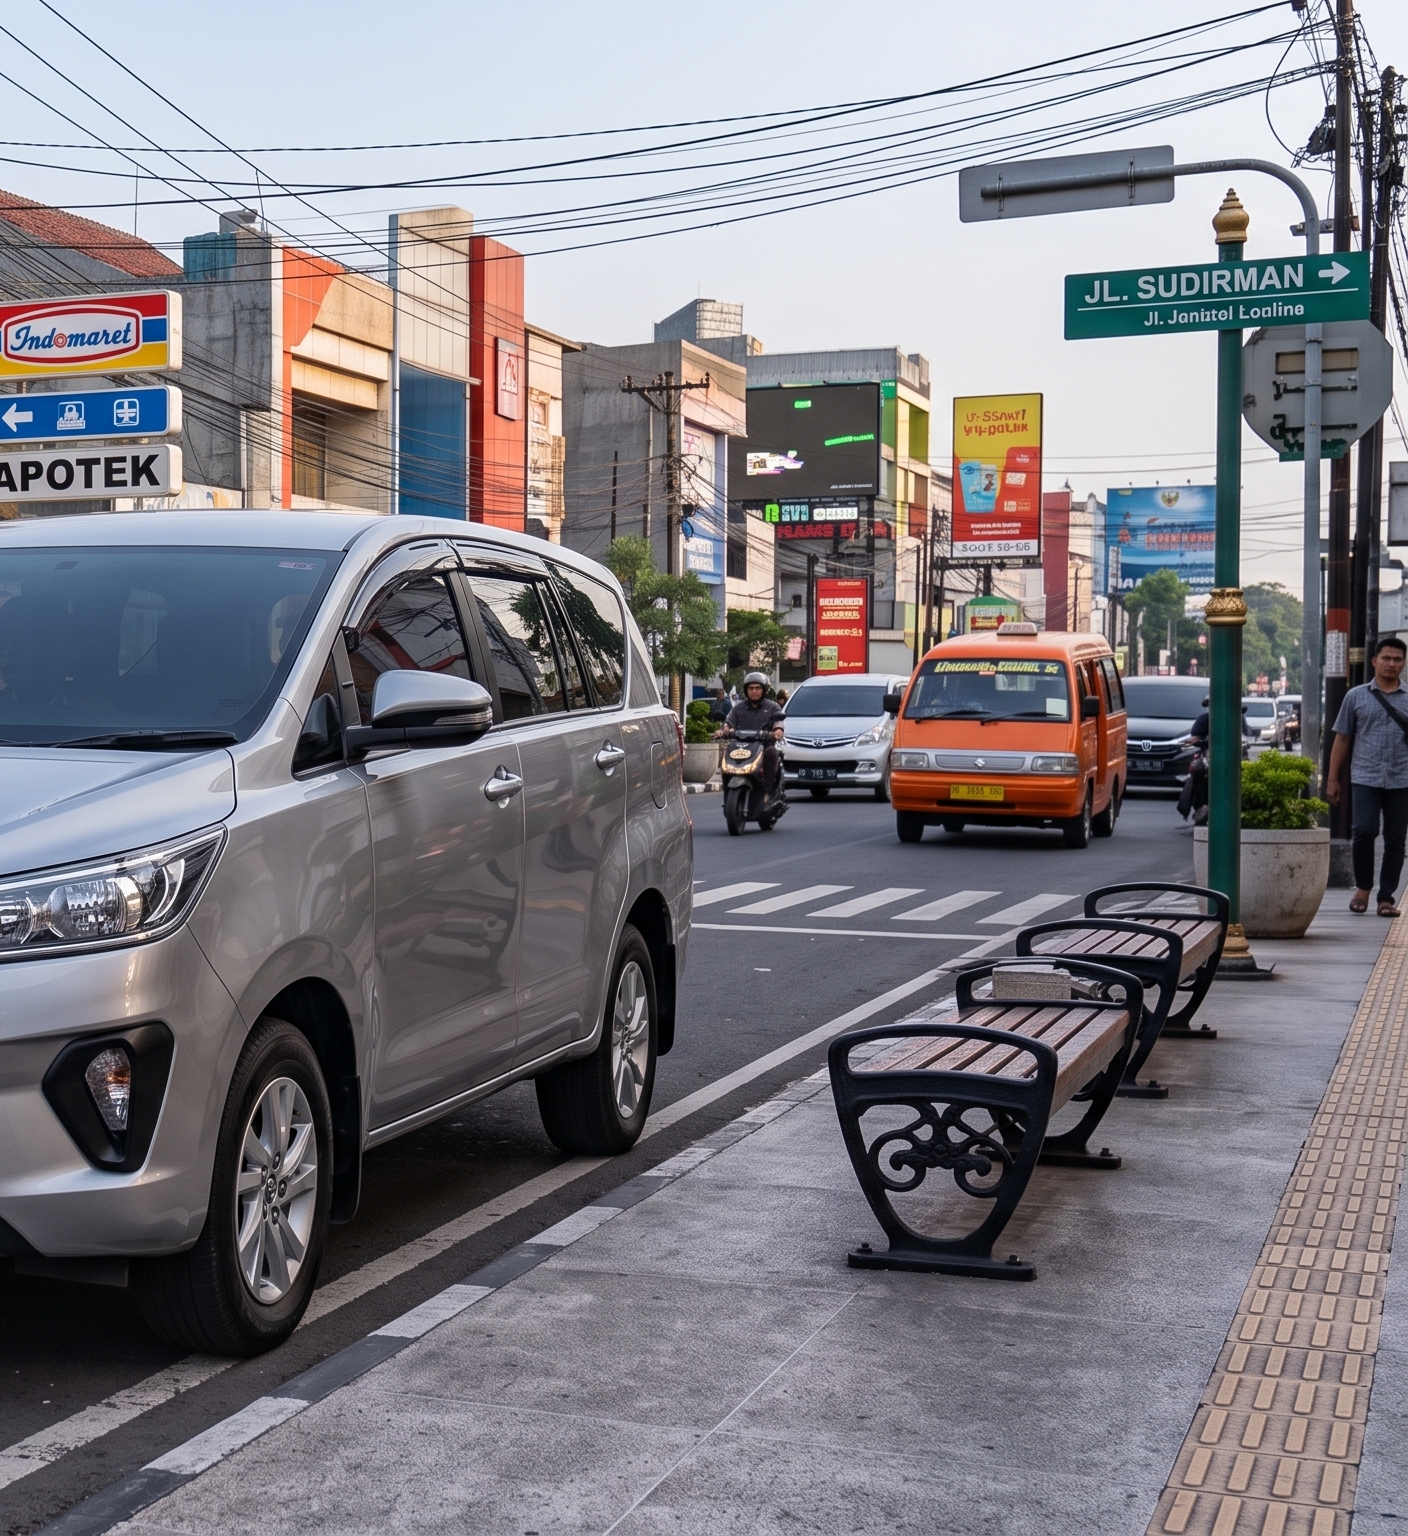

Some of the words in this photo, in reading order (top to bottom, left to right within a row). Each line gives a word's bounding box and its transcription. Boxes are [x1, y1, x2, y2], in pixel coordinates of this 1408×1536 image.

[1084, 280, 1128, 304] JL.
[1137, 263, 1304, 300] SUDIRMAN
[10, 322, 132, 351] Indomaret
